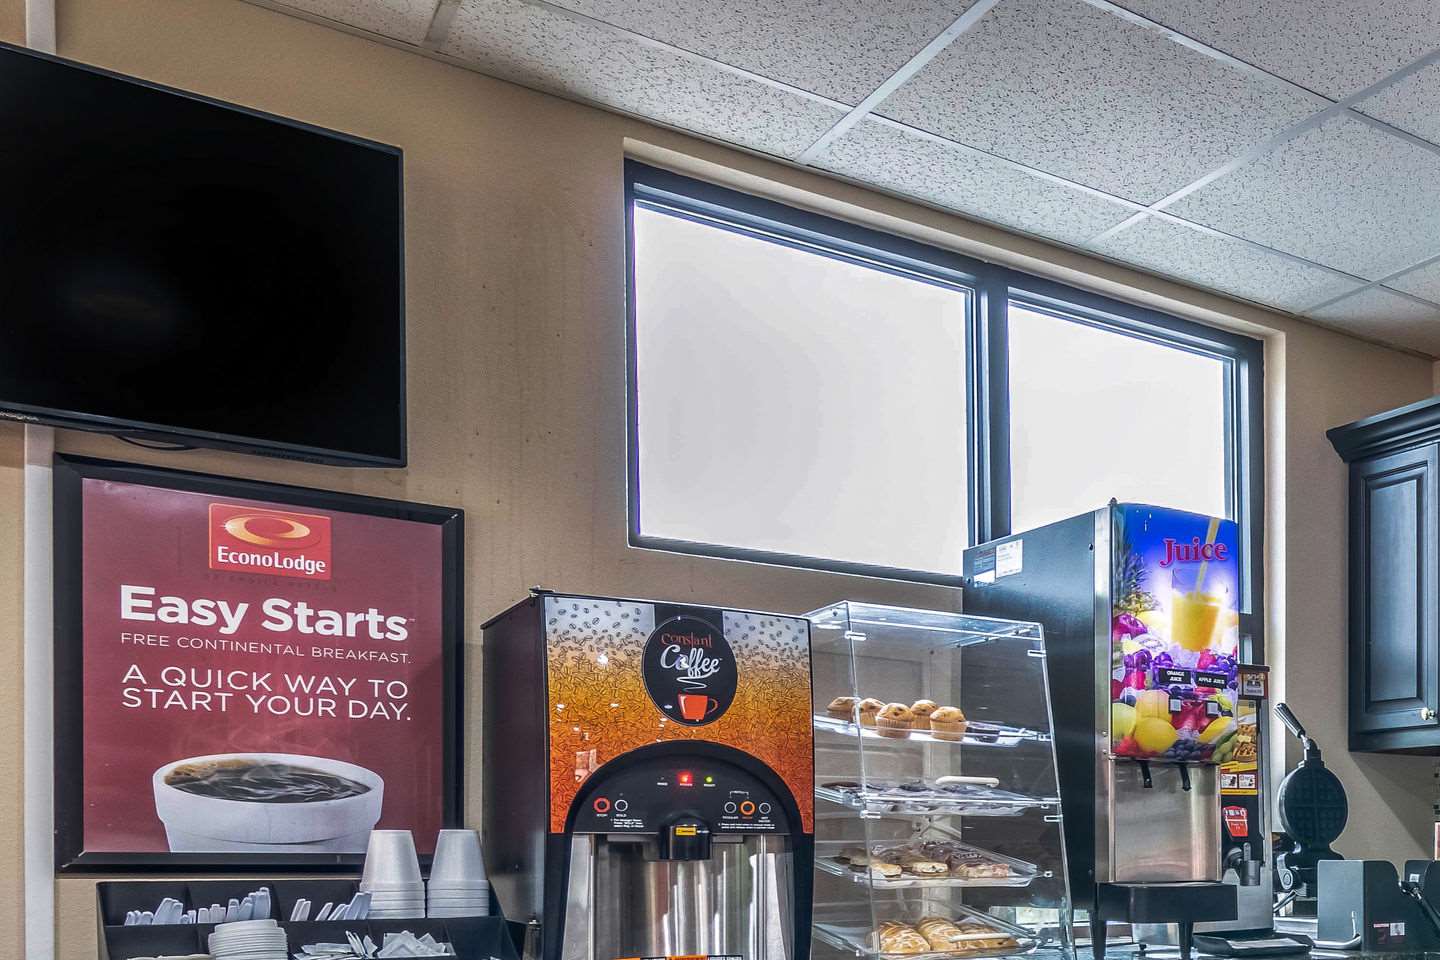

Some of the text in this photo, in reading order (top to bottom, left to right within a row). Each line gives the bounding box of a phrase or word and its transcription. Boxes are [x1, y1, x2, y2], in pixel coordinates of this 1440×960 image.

[217, 546, 326, 575] EconoLodge
[1159, 536, 1228, 568] Juice
[121, 584, 408, 641] Easy Starts
[121, 633, 411, 664] FREE CONTINENTAL BREAKFAST.
[661, 632, 712, 648] Constant
[660, 644, 720, 677] Coffee
[122, 664, 408, 699] A QUICK WAY TO
[122, 687, 411, 721] START YOUR DAY.
